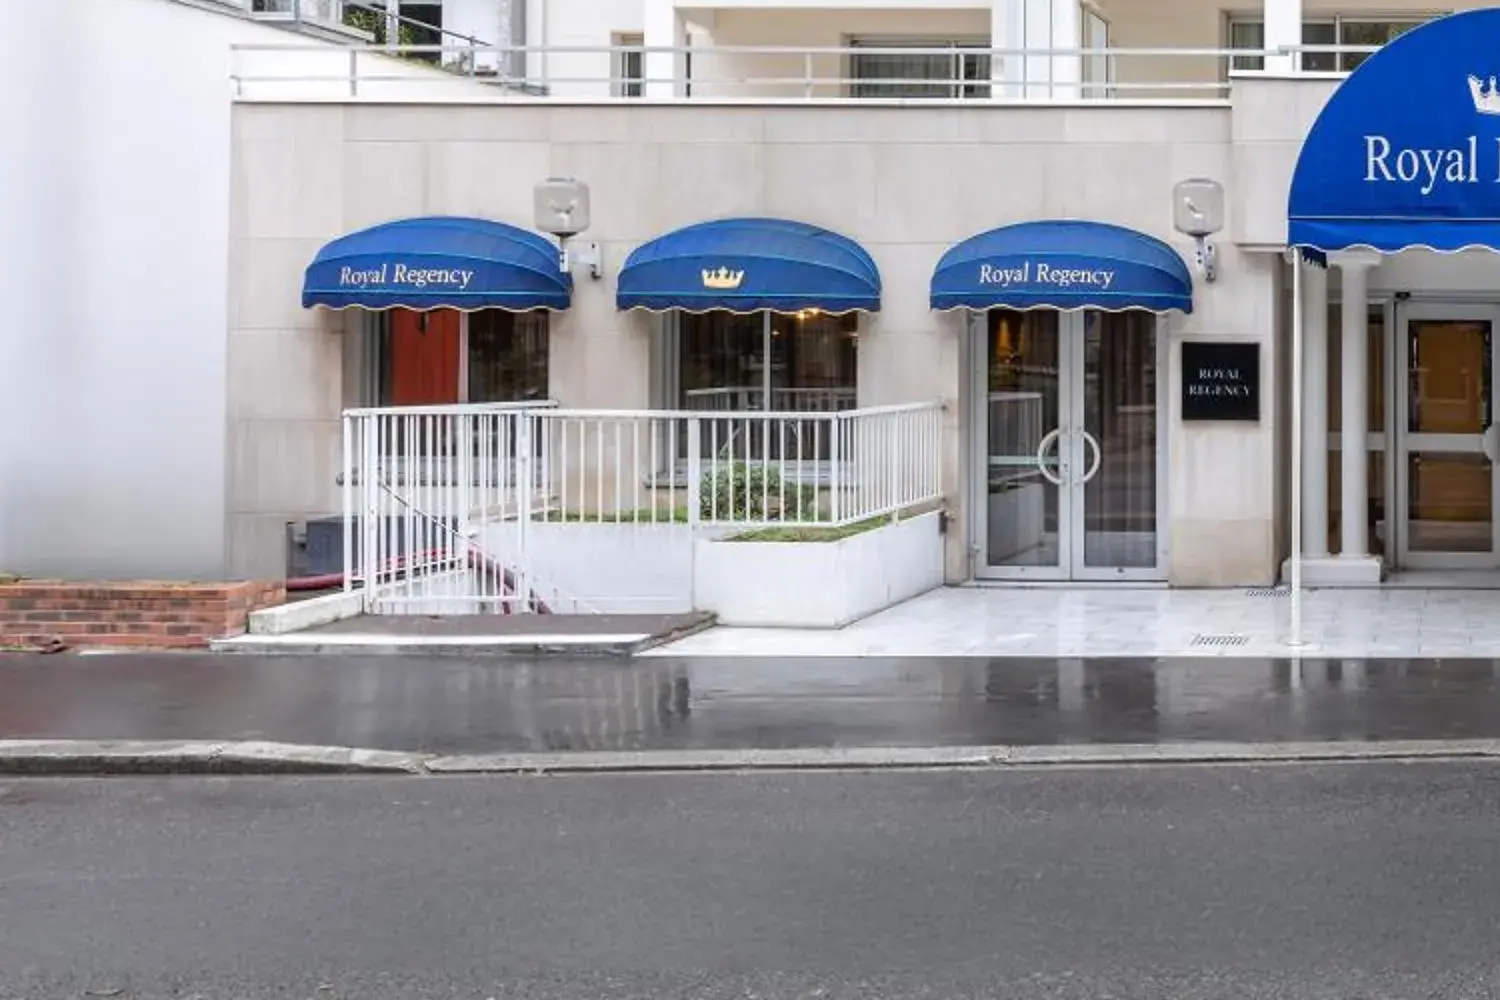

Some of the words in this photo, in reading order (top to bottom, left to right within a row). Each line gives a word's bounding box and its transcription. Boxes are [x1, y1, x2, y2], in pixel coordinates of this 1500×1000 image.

[1363, 135, 1479, 195] Royal
[339, 263, 387, 289] Royal
[392, 263, 474, 289] Regency
[979, 260, 1029, 287] Royal
[1035, 263, 1115, 289] Regency
[1199, 368, 1241, 380] ROYAL
